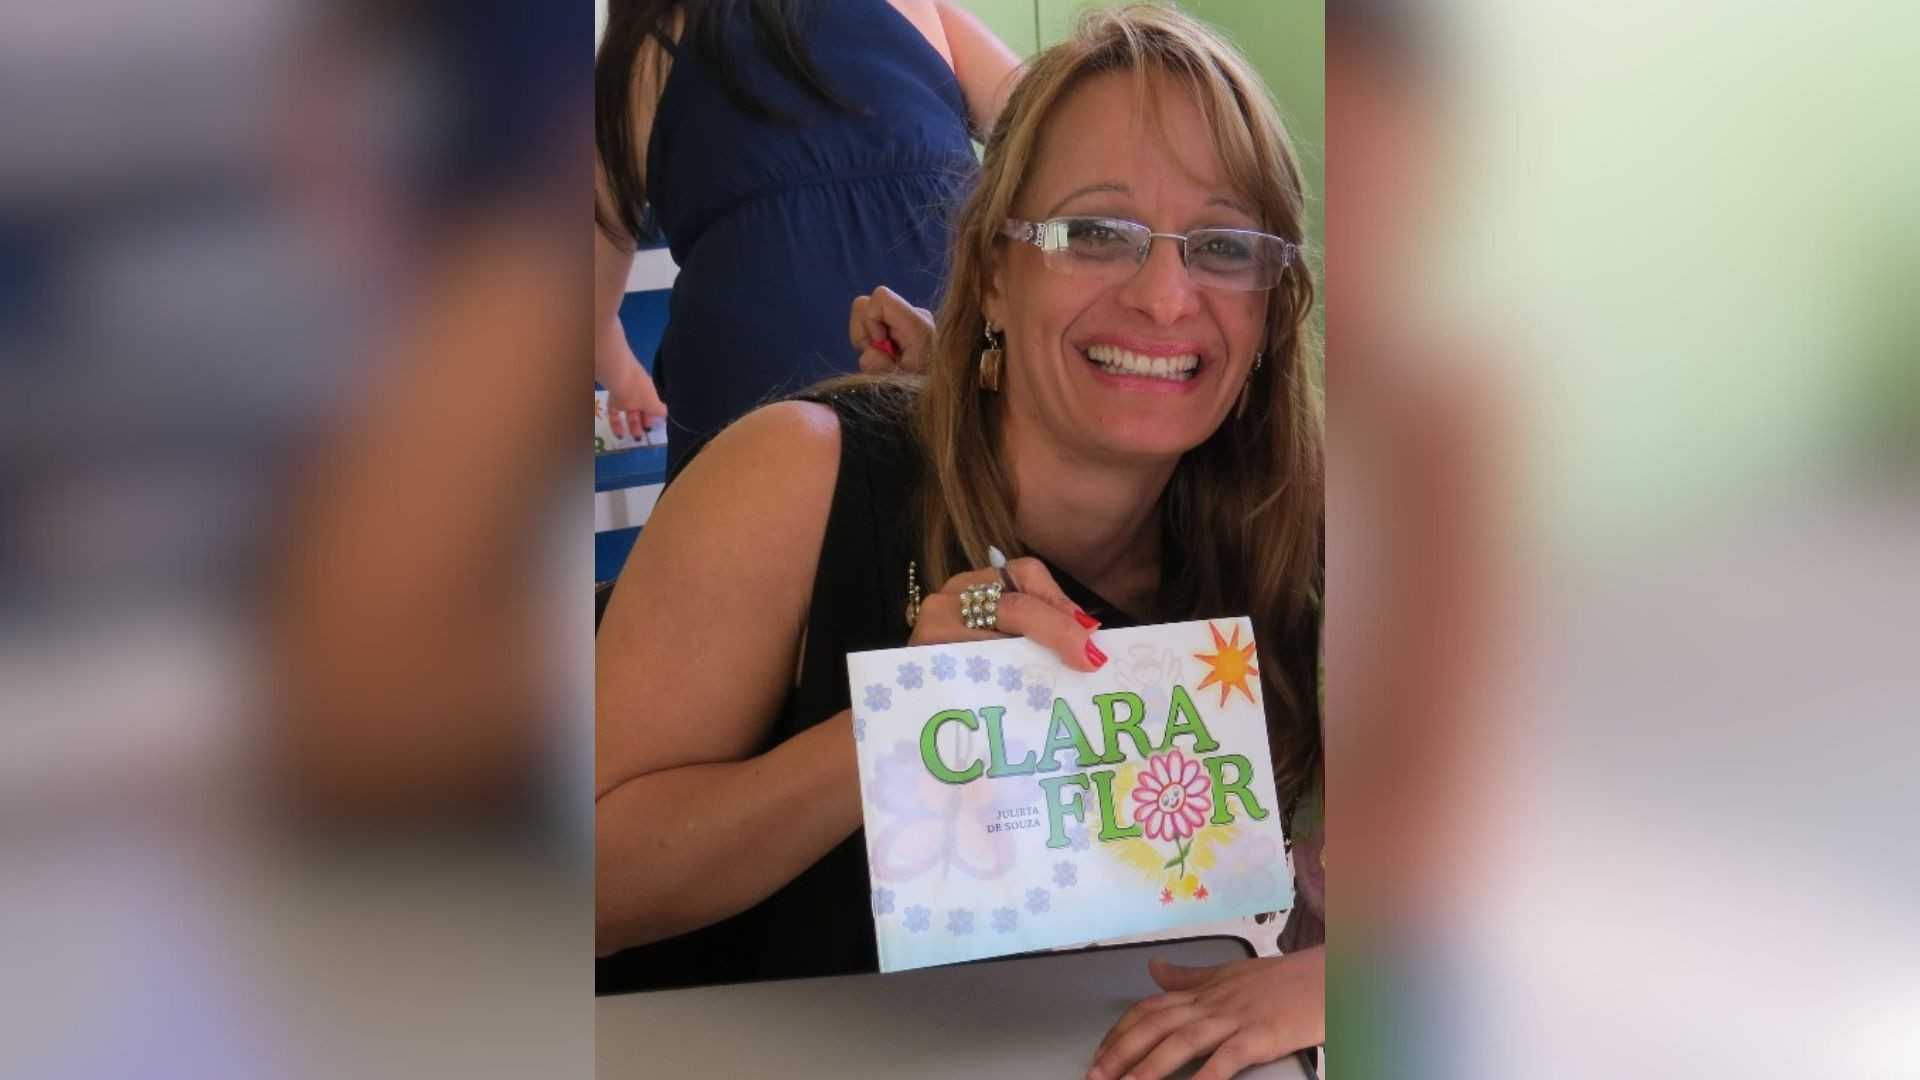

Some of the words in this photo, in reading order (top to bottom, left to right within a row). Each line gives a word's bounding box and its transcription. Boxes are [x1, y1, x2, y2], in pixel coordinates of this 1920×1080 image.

[919, 684, 1220, 785] CLARA
[996, 806, 1040, 821] JULIETA
[987, 823, 1002, 833] DE
[1004, 819, 1040, 831] SOUZA
